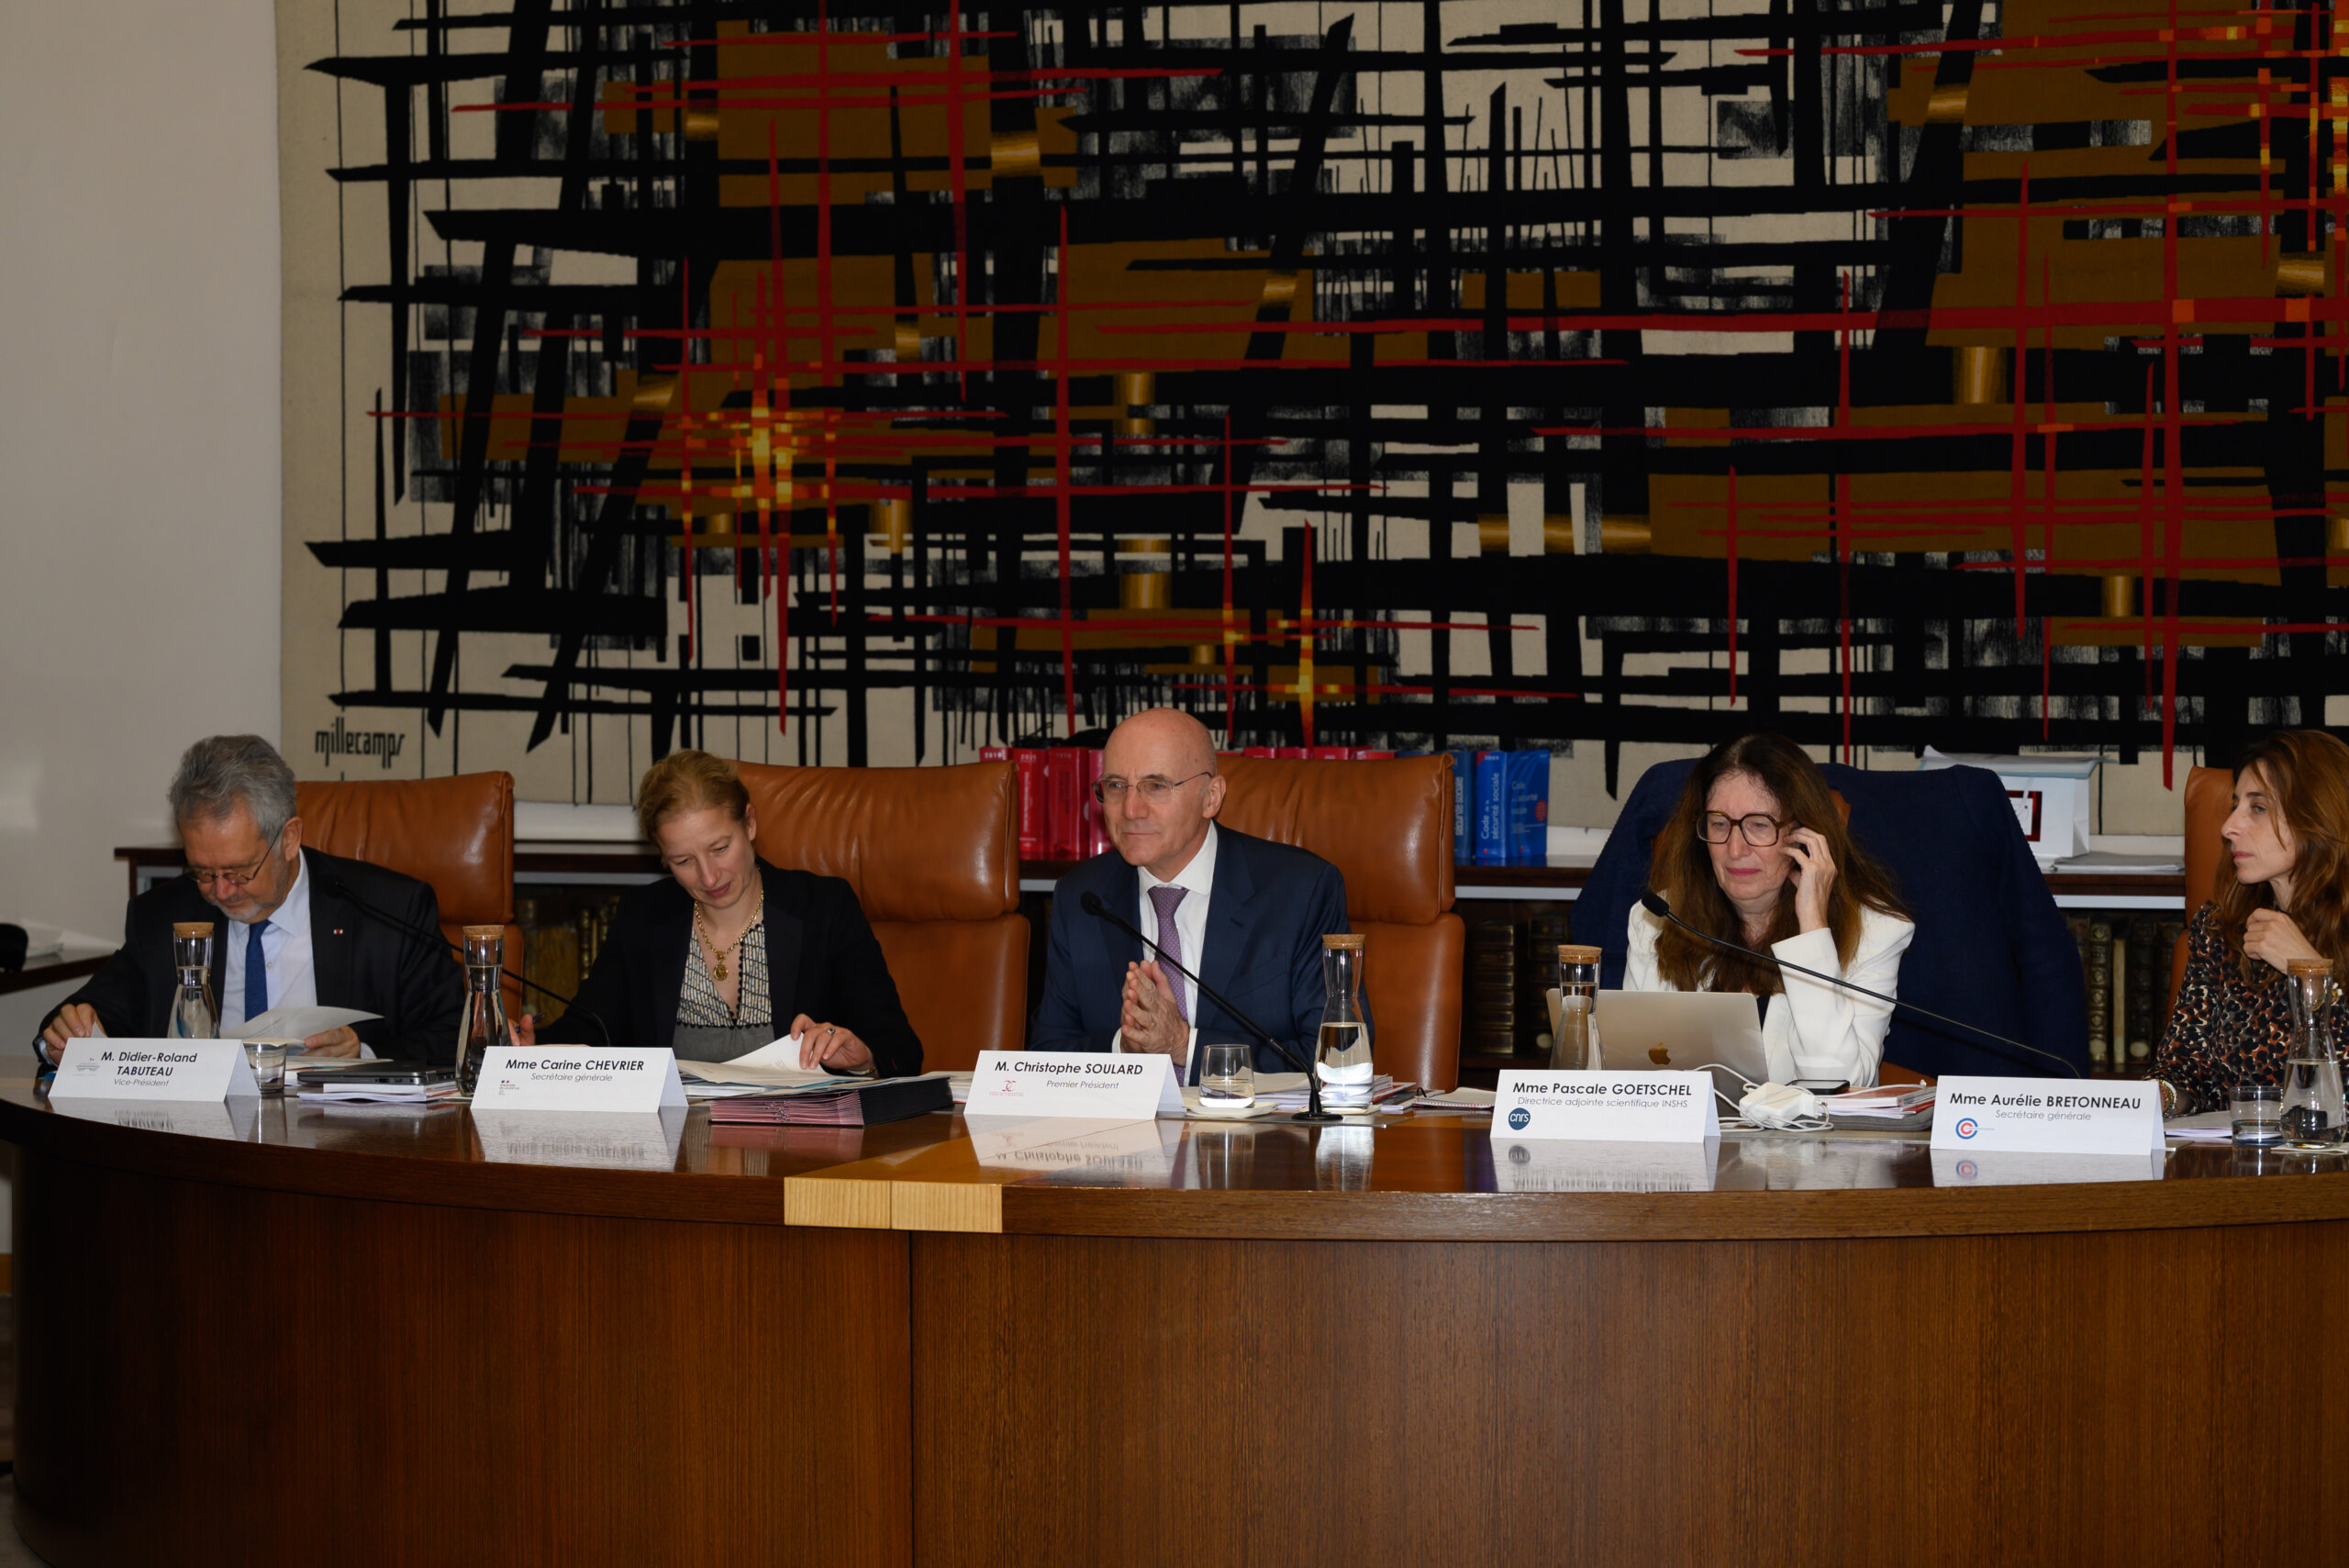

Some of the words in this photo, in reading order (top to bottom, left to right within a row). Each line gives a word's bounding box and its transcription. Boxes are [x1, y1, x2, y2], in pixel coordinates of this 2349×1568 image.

[1481, 815, 1489, 840] Code
[101, 1051, 116, 1062] M.
[118, 1051, 197, 1062] Didier-Roland
[117, 1066, 173, 1076] TABUTEAU
[506, 1059, 537, 1070] Mme
[541, 1060, 582, 1071] Carine
[585, 1060, 644, 1072] CHEVRIER
[995, 1062, 1009, 1072] M.
[1014, 1062, 1082, 1075] Christophe
[1085, 1063, 1143, 1075] SOULARD
[114, 1078, 169, 1087] Vice-Président
[530, 1073, 573, 1082] Secrétaire
[574, 1073, 613, 1083] générale
[1046, 1080, 1078, 1089] Premier
[1081, 1081, 1119, 1090] Président
[1512, 1083, 1548, 1094] Mme
[1553, 1083, 1607, 1095] Pascale
[1611, 1084, 1692, 1095] GOETSCHEL
[1517, 1096, 1563, 1106] Directrice
[1564, 1097, 1604, 1107] adjointe
[1606, 1098, 1659, 1108] scientifique
[1662, 1099, 1688, 1108] INSHS
[1949, 1093, 1987, 1105] Mme
[1990, 1094, 2042, 1106] Aurélie
[2046, 1095, 2142, 1109] BRETONNEAU
[1509, 1113, 1530, 1123] cnrs
[1995, 1109, 2045, 1119] Secrétaire
[2047, 1111, 2092, 1121] générale
